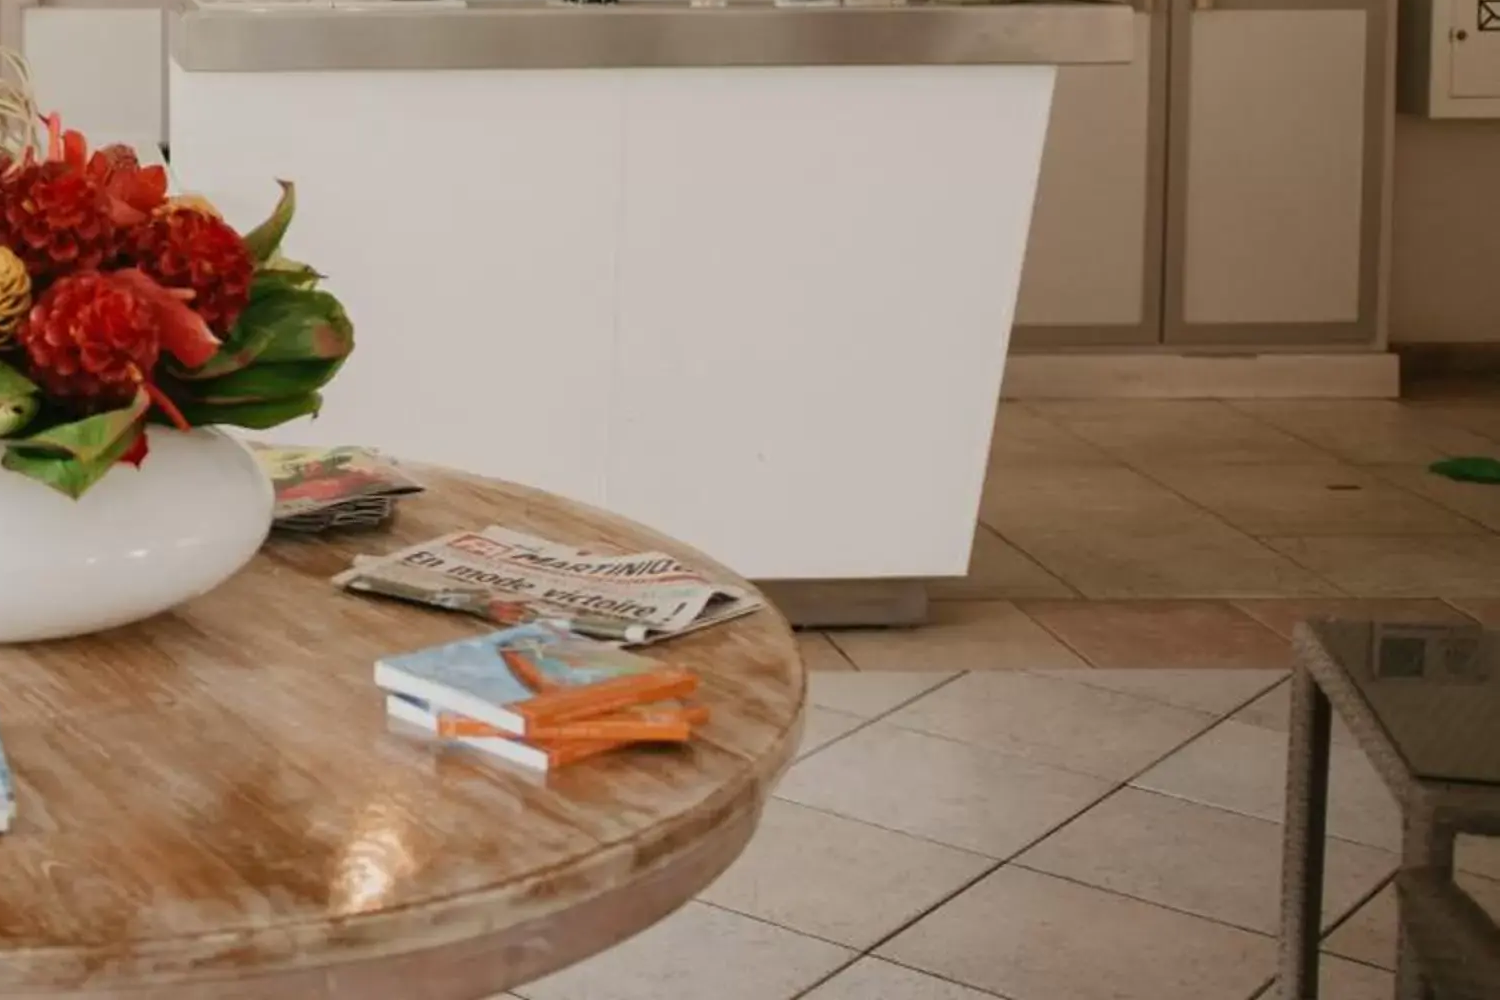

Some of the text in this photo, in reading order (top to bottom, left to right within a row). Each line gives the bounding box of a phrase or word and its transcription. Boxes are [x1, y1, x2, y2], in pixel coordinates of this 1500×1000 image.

[402, 550, 445, 568] En
[448, 565, 537, 592] mode
[543, 587, 657, 619] victoire
